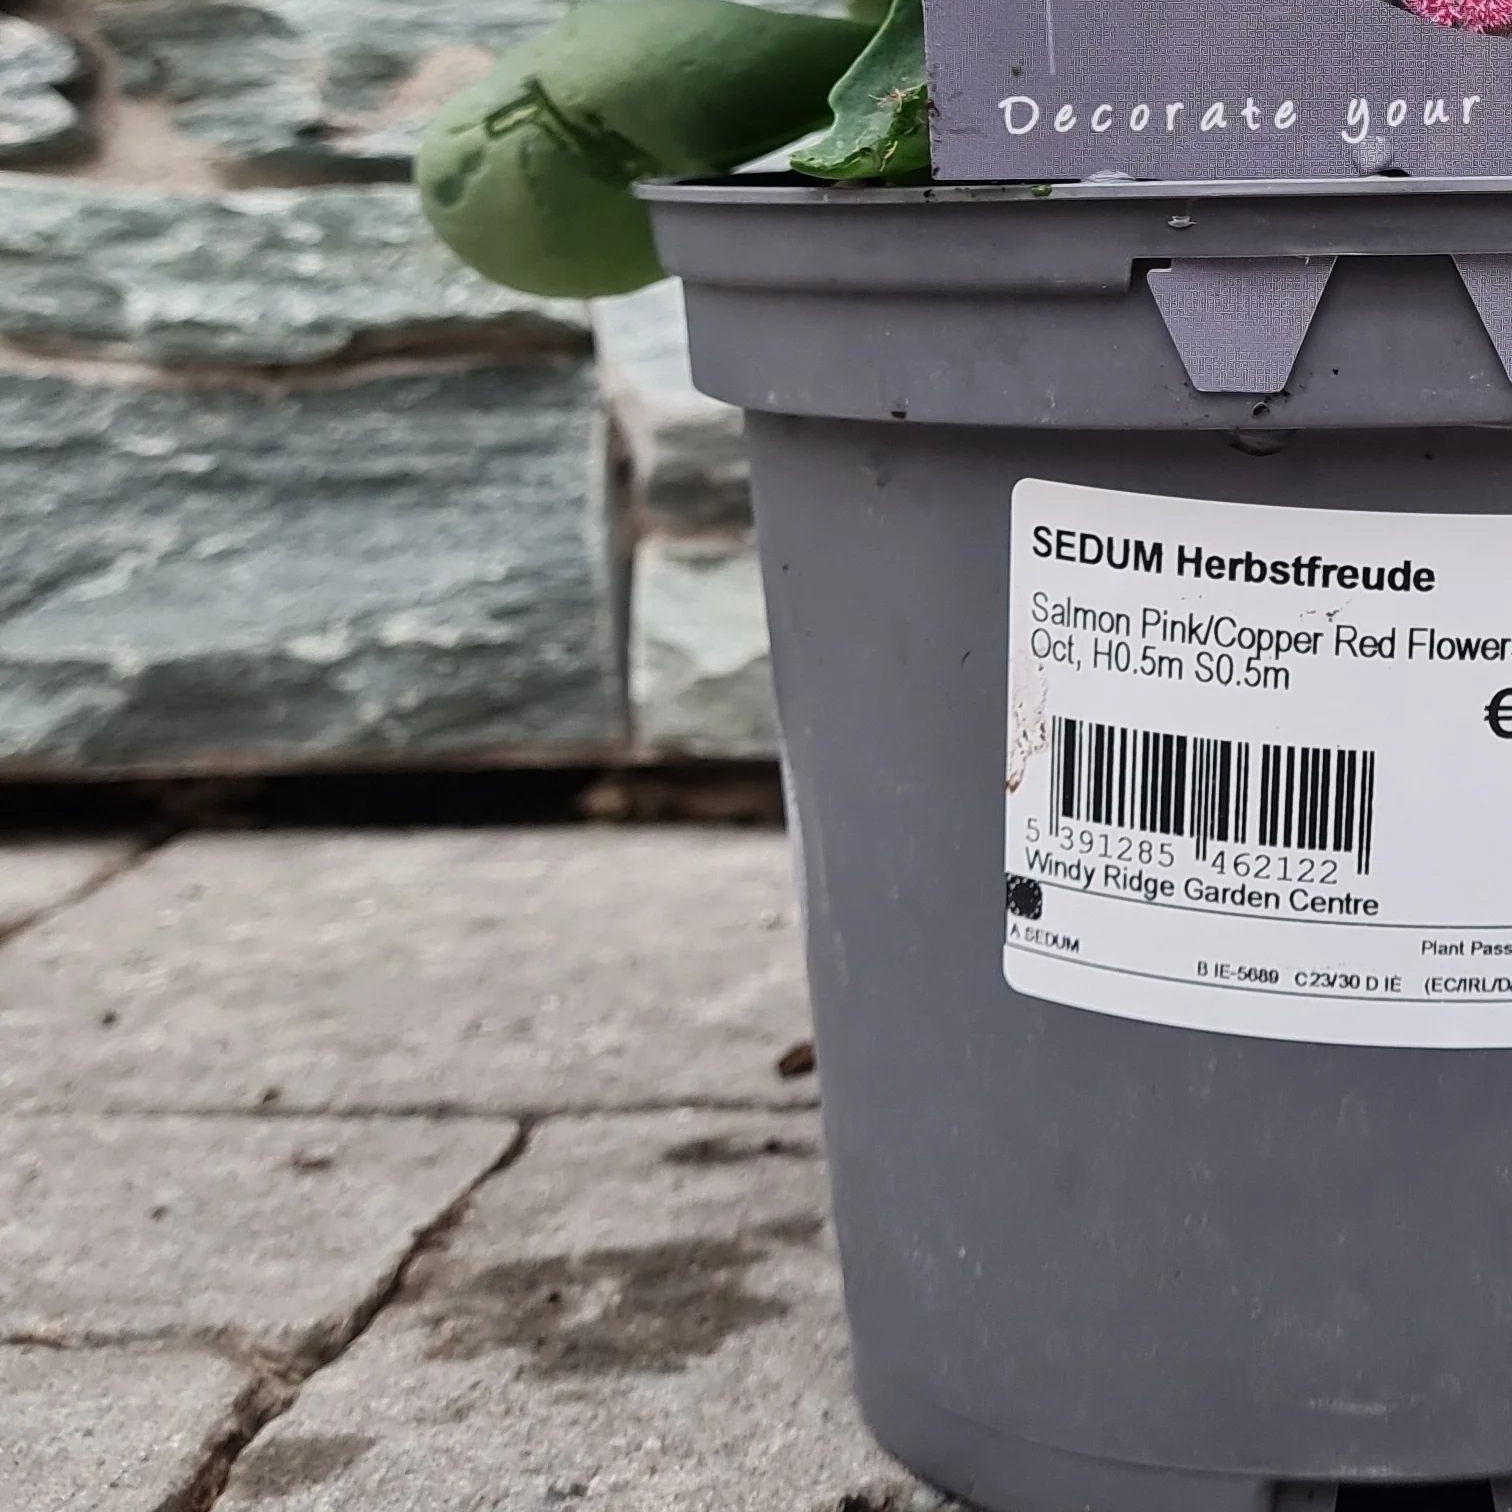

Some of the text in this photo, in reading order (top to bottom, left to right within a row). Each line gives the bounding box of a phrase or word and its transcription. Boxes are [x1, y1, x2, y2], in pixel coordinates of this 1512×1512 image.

[998, 95, 1298, 135] Decorate
[1341, 94, 1481, 143] your
[1032, 525, 1436, 592] SEDUM Herbstfreude
[1031, 591, 1130, 637] Salmon
[1142, 607, 1323, 660] Pink/Copper
[1334, 625, 1396, 659] Red
[1031, 628, 1290, 690] Oct, H0.5m S0.5m
[1025, 817, 1339, 885] 5 391285 462122
[1025, 846, 1379, 916] Windy Ridge Garden Centre
[1421, 940, 1465, 956] Plant
[1366, 976, 1379, 992] D
